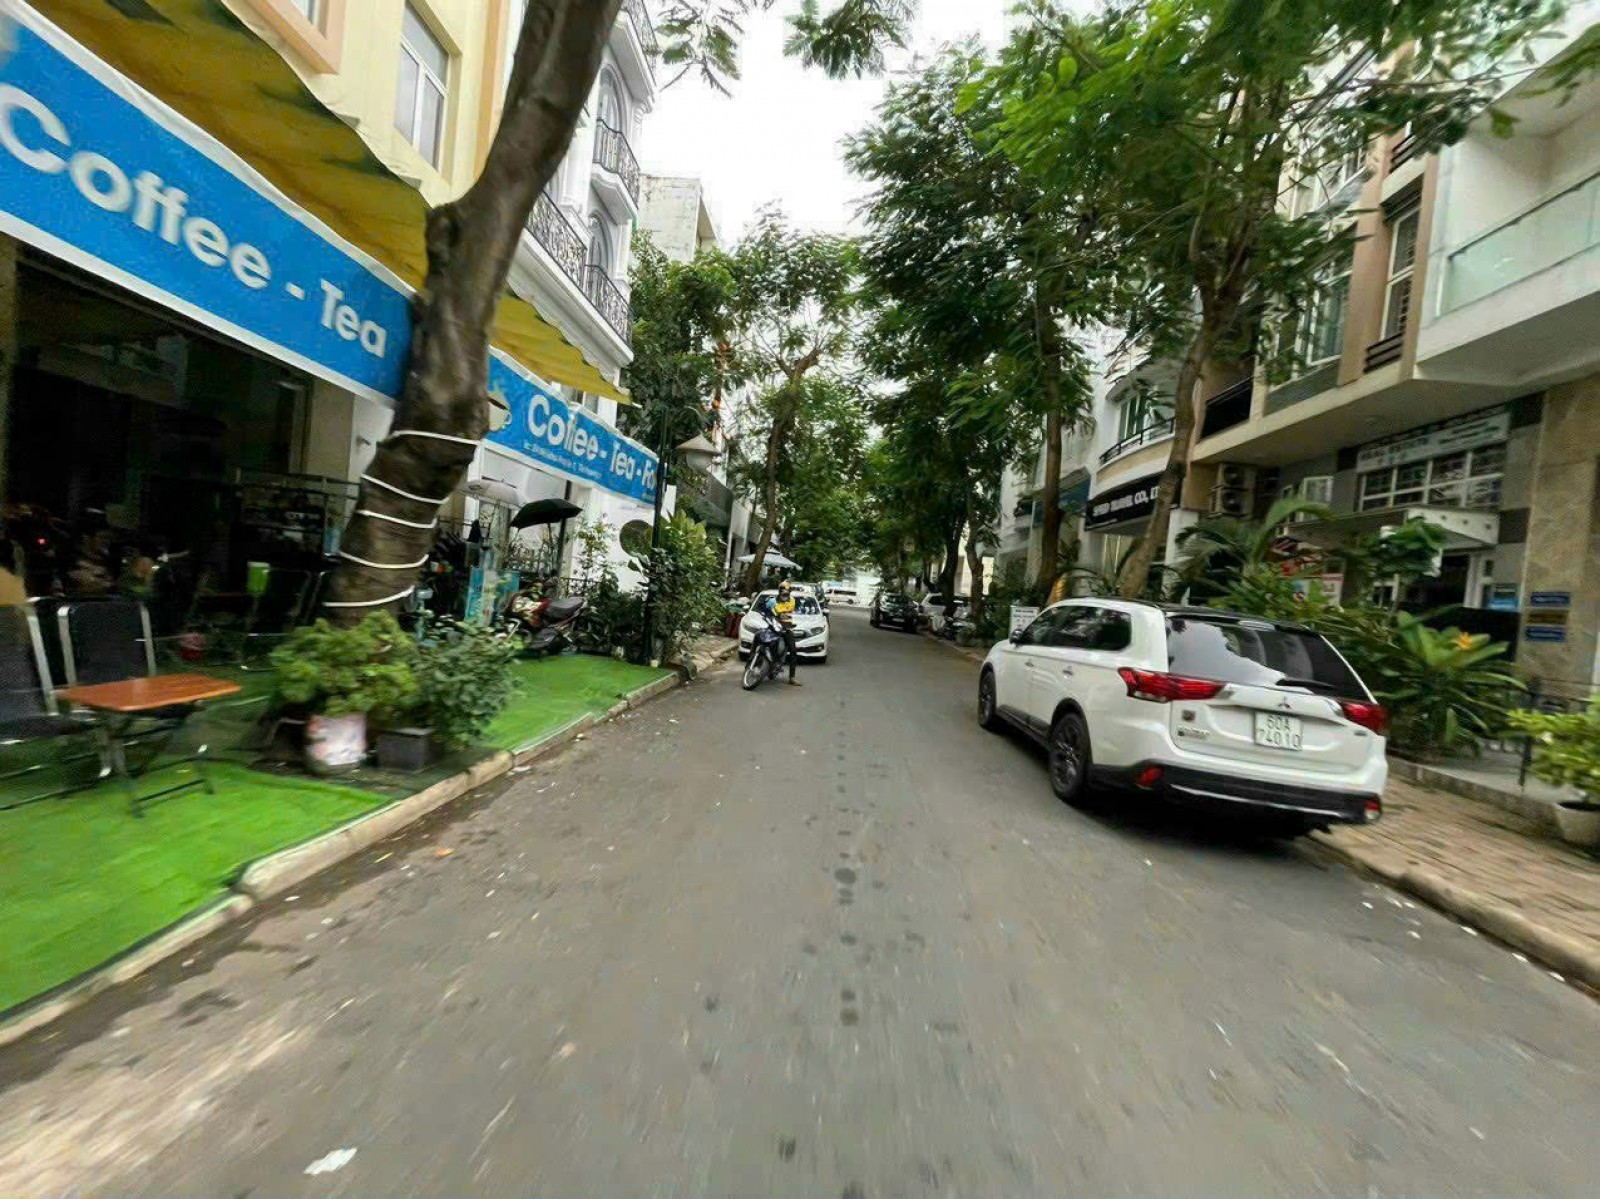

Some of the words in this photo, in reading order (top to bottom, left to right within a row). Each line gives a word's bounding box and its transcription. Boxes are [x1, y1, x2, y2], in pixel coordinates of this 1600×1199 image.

[0, 83, 272, 289] Coffee
[320, 278, 387, 358] Tea
[611, 440, 636, 481] Tea
